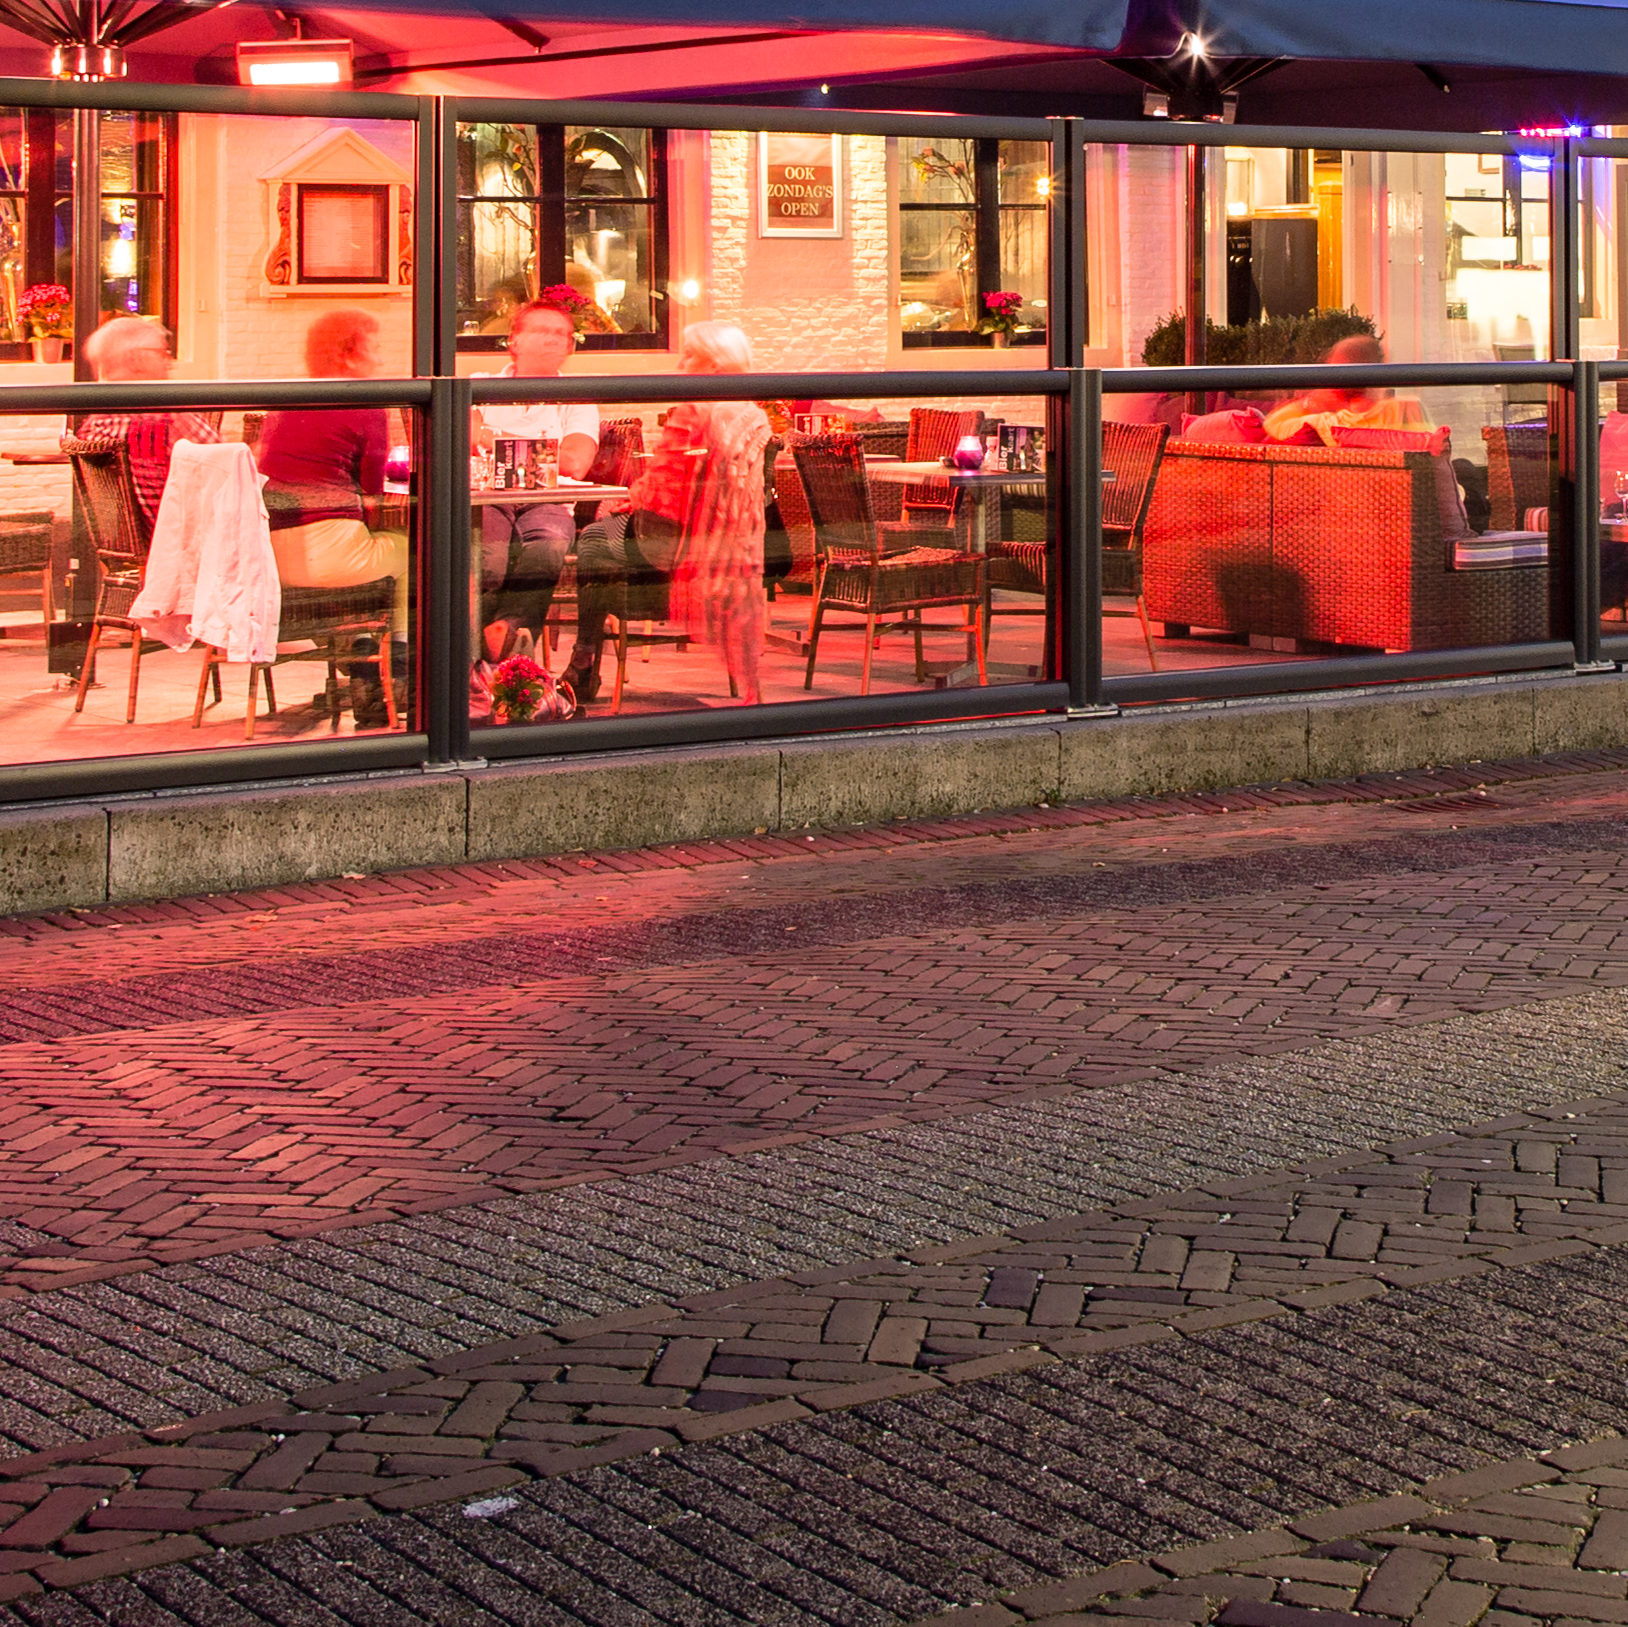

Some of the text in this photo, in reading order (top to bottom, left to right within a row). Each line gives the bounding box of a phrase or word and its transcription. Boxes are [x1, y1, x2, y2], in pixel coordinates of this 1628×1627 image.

[784, 166, 816, 181] OOK
[767, 183, 833, 199] ZONDAG'S
[780, 201, 819, 216] OPEN
